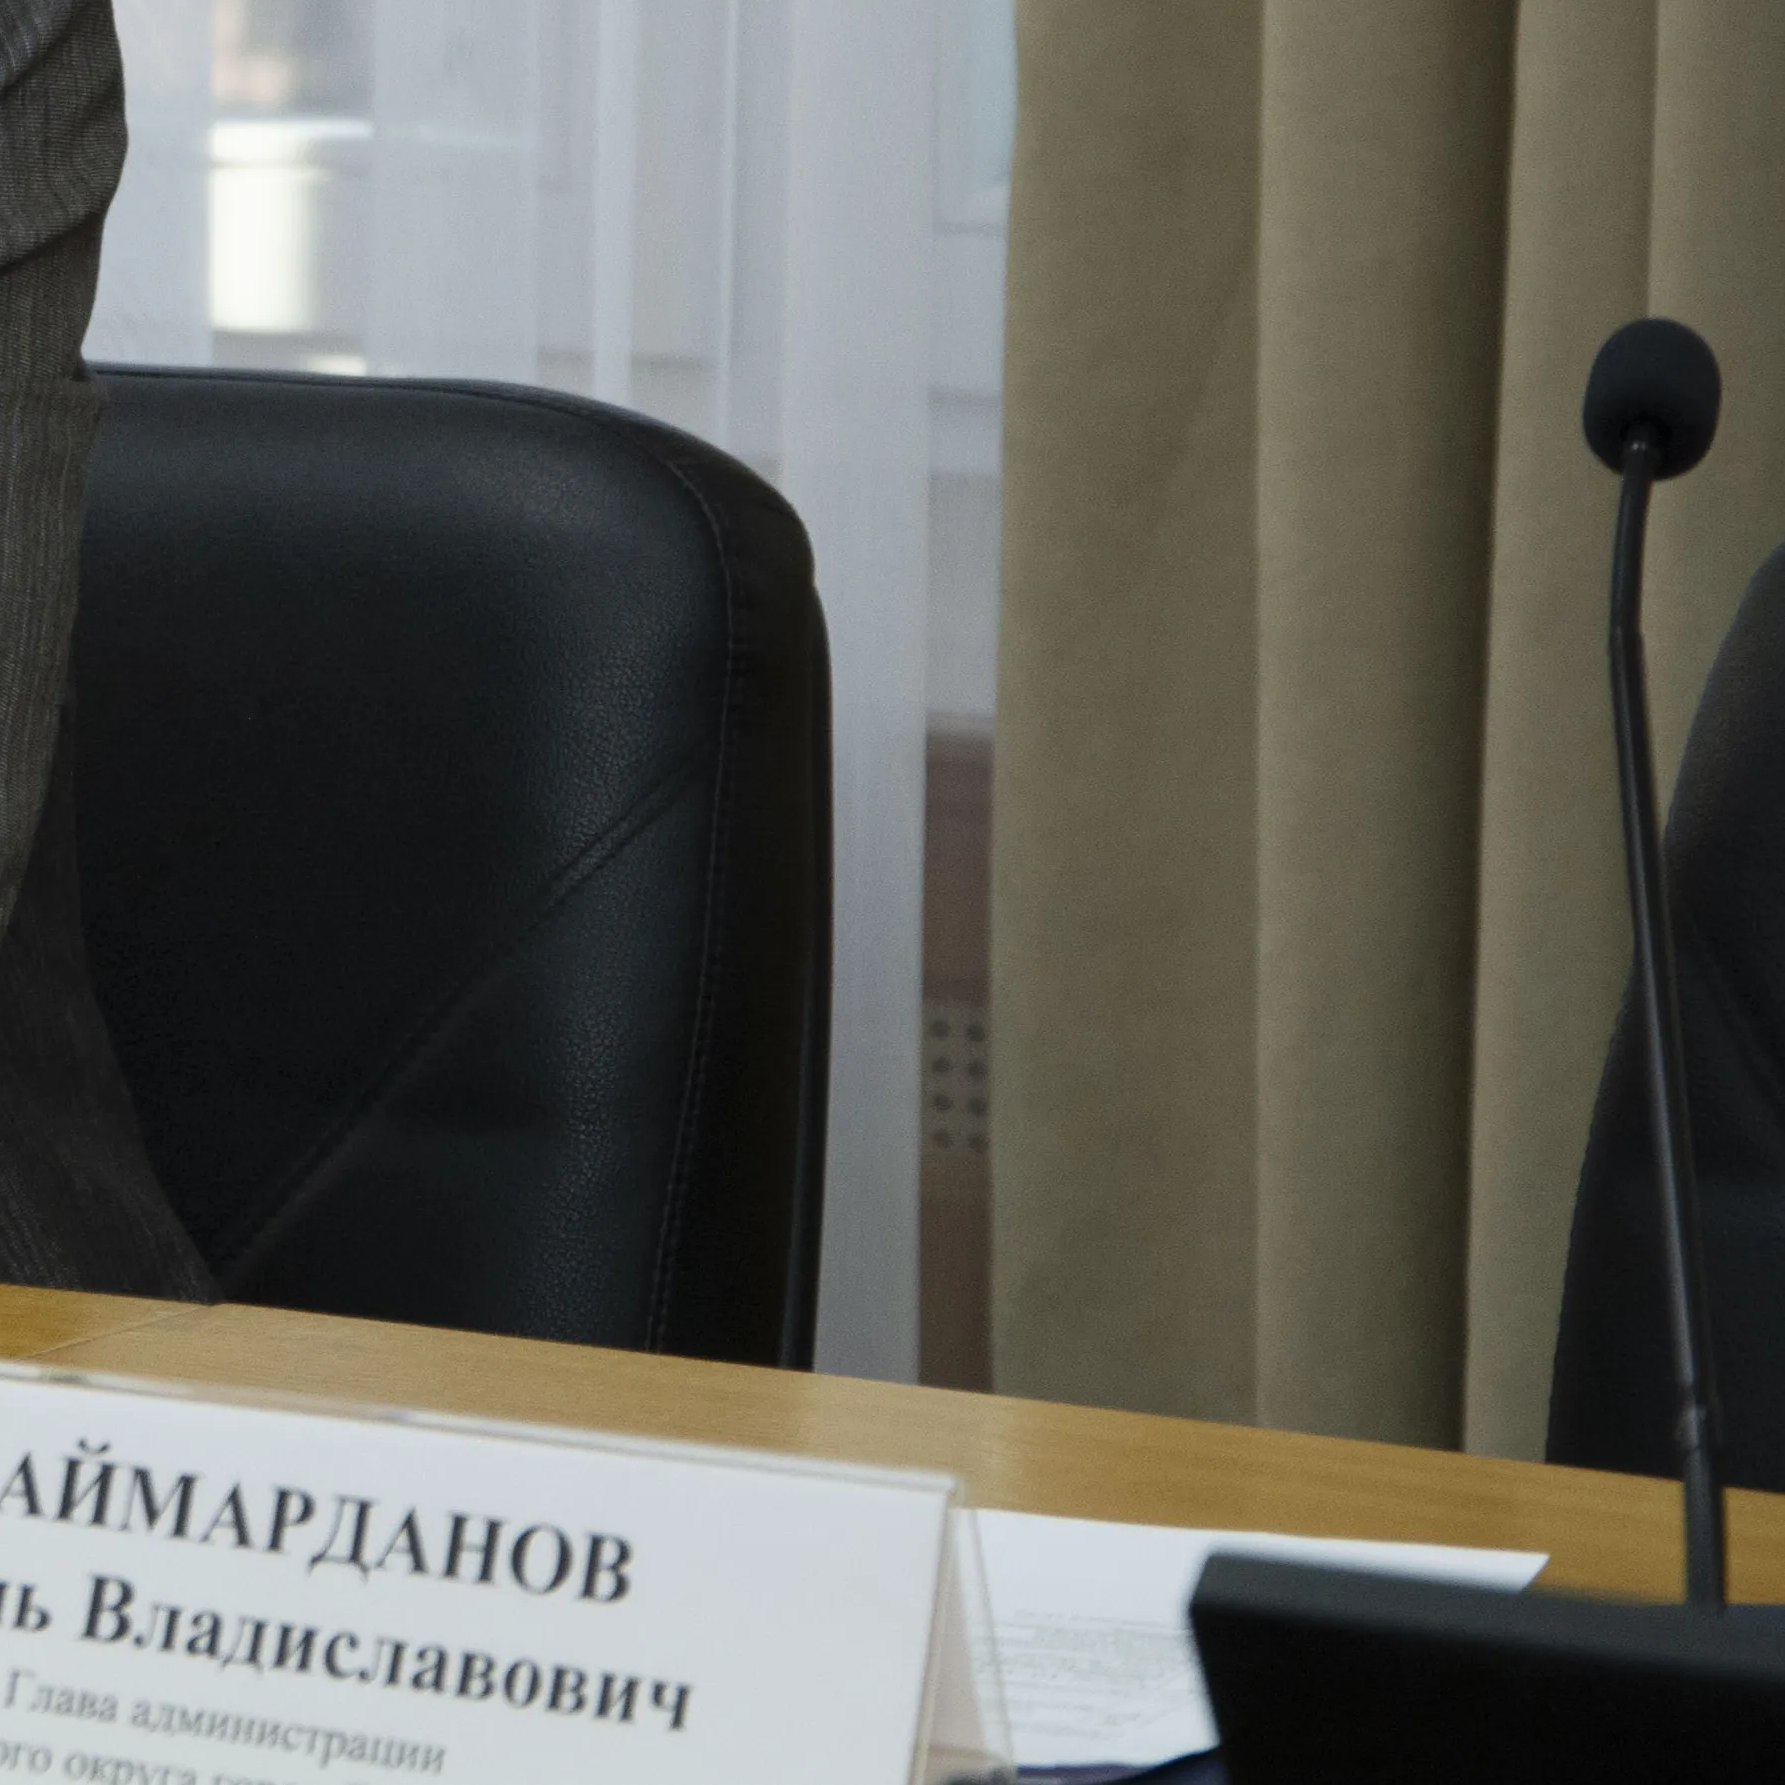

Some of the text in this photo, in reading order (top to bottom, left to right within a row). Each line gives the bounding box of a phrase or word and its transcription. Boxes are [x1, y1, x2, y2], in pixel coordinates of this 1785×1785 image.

[77, 1571, 694, 1734] Владиславович
[3, 1667, 447, 1777] Глава администрации
